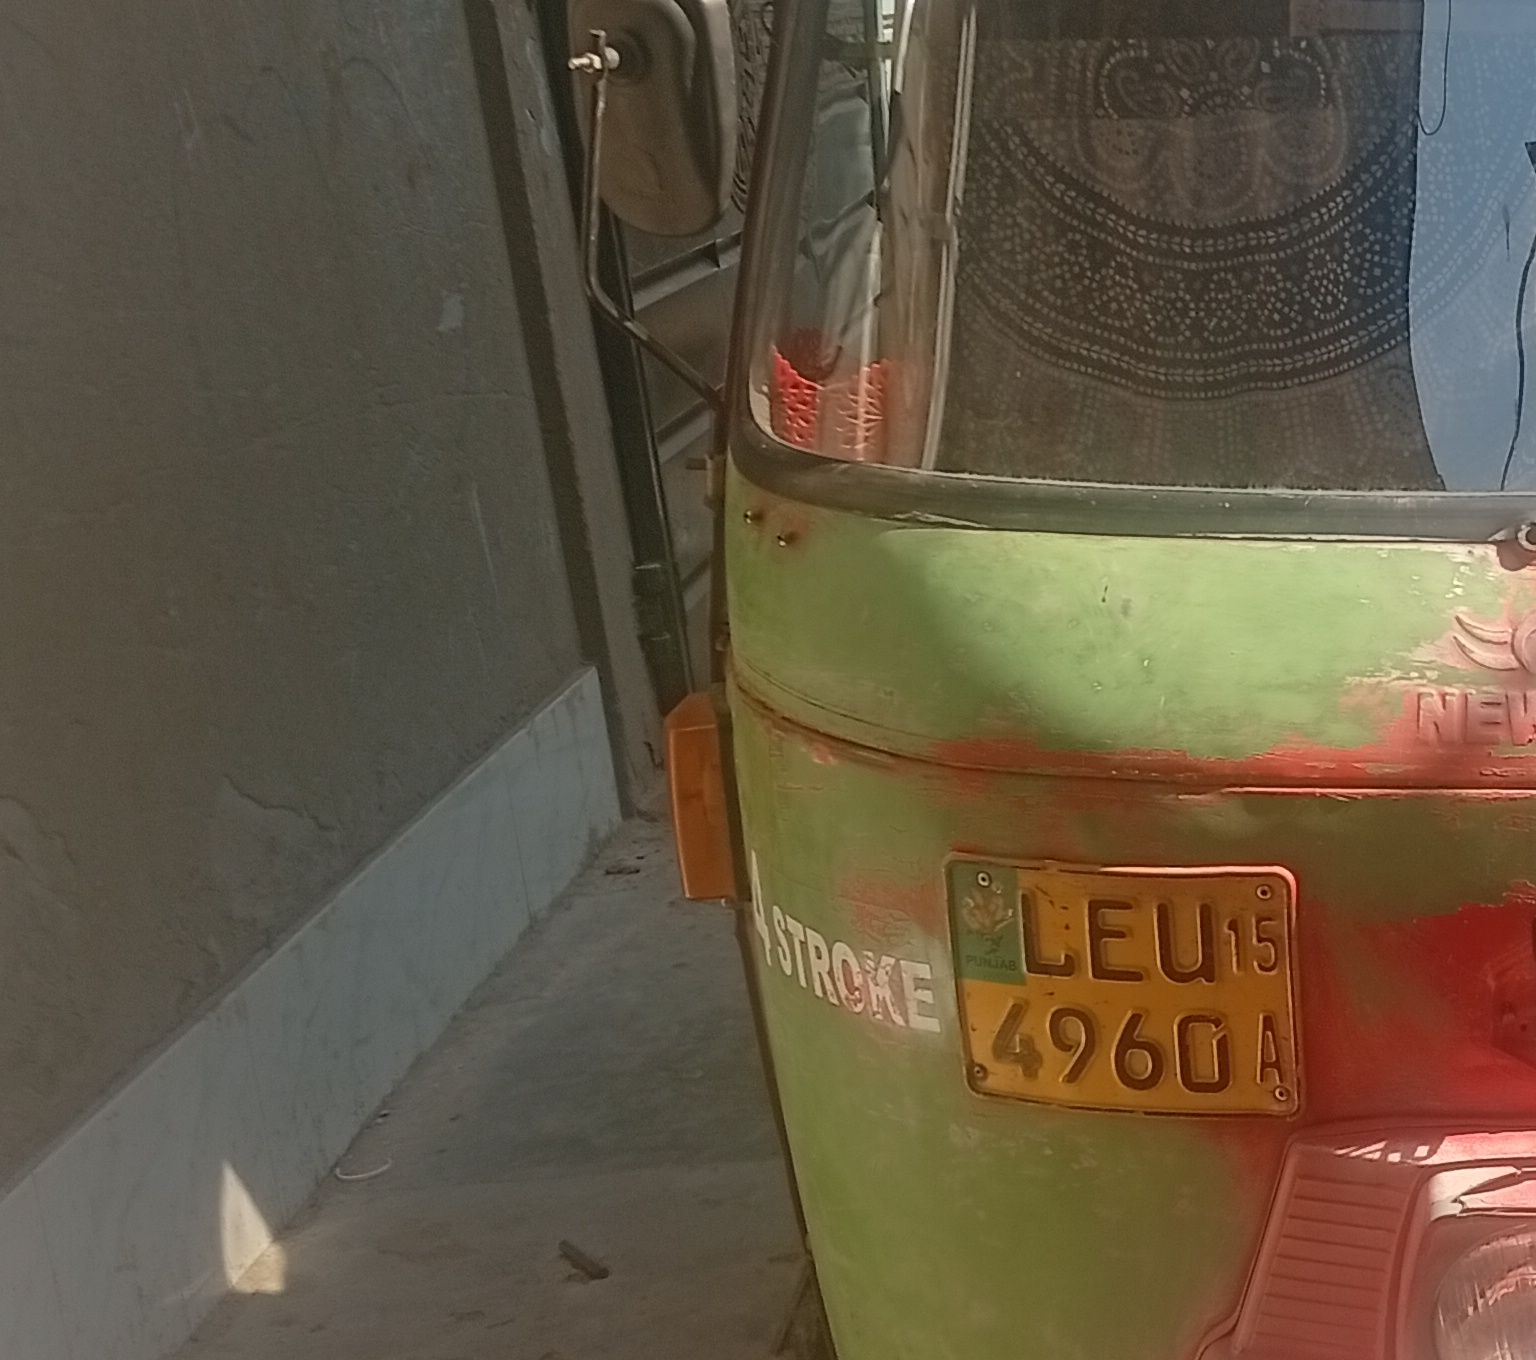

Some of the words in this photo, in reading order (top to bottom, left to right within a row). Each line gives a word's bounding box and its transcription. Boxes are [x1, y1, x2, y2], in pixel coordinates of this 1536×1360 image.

[751, 848, 772, 968] 4
[772, 904, 942, 1033] STROKE
[965, 954, 1018, 972] PUNJAB
[1017, 887, 1215, 986] LEU
[1222, 914, 1279, 975] 15
[991, 996, 1232, 1094] 4960
[1254, 1010, 1283, 1087] A
